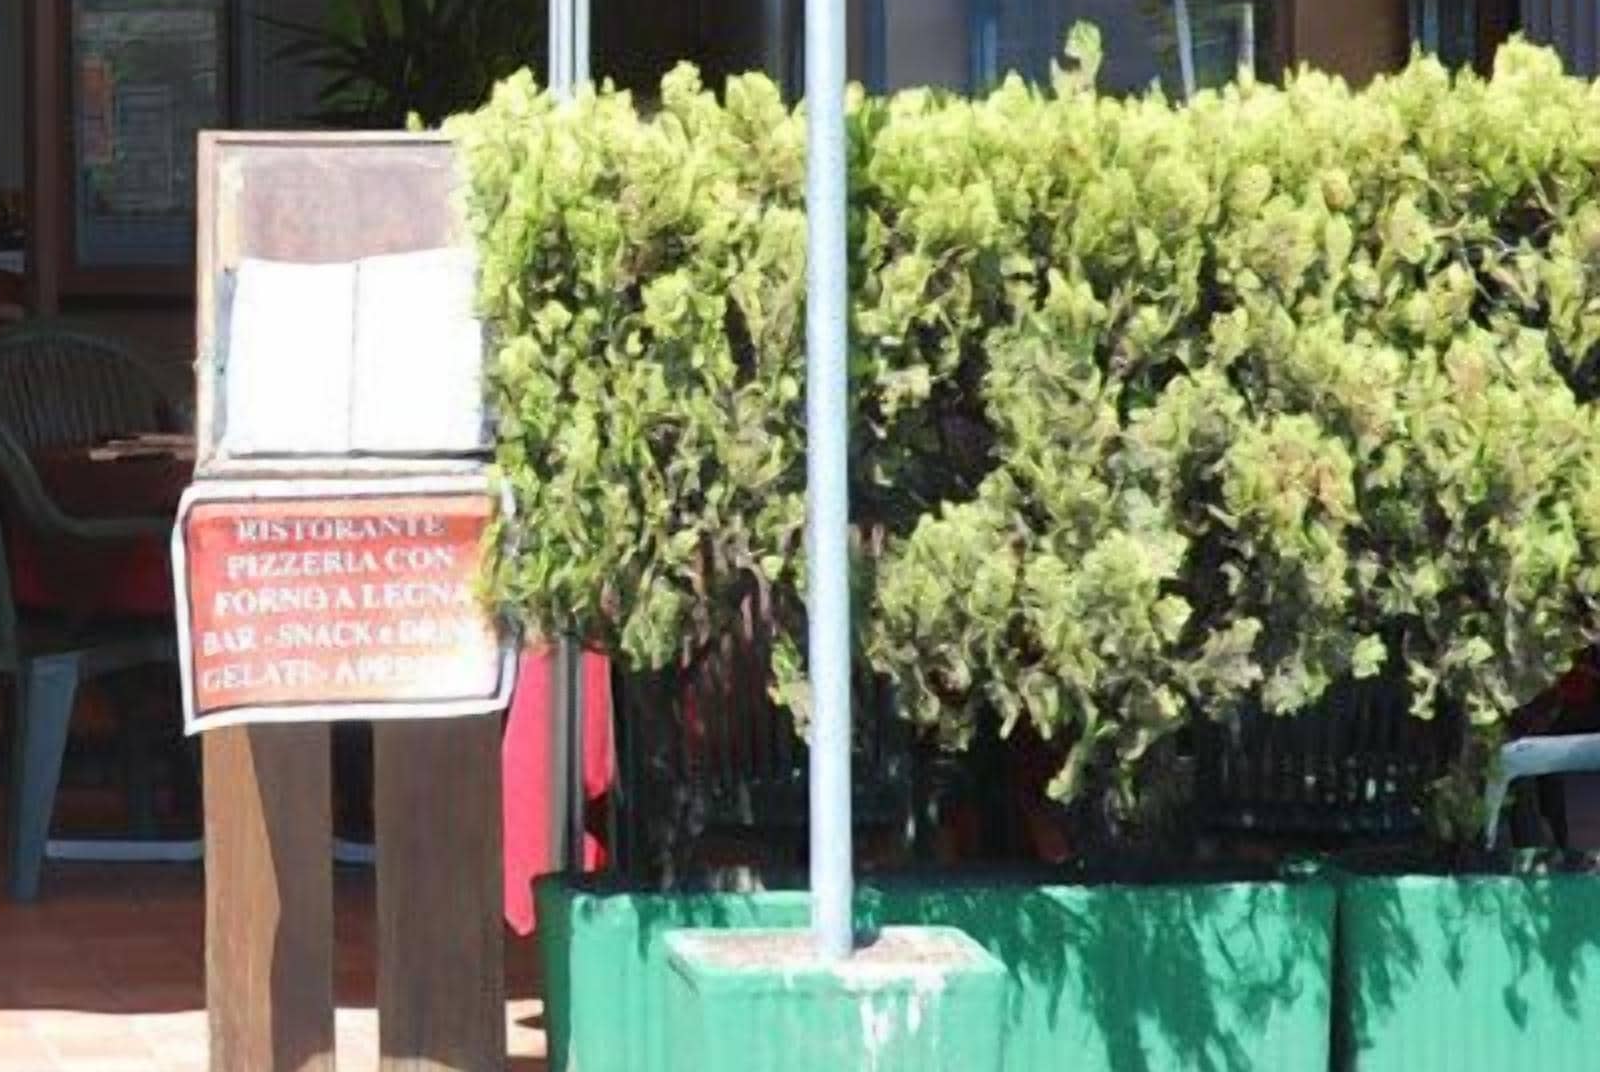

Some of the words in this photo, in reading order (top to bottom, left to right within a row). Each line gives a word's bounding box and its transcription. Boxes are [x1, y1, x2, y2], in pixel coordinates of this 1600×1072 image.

[236, 514, 446, 543] RISTORANTE
[226, 548, 382, 581] PIZZERIA
[384, 545, 456, 574] CON
[213, 583, 332, 616] FORNO
